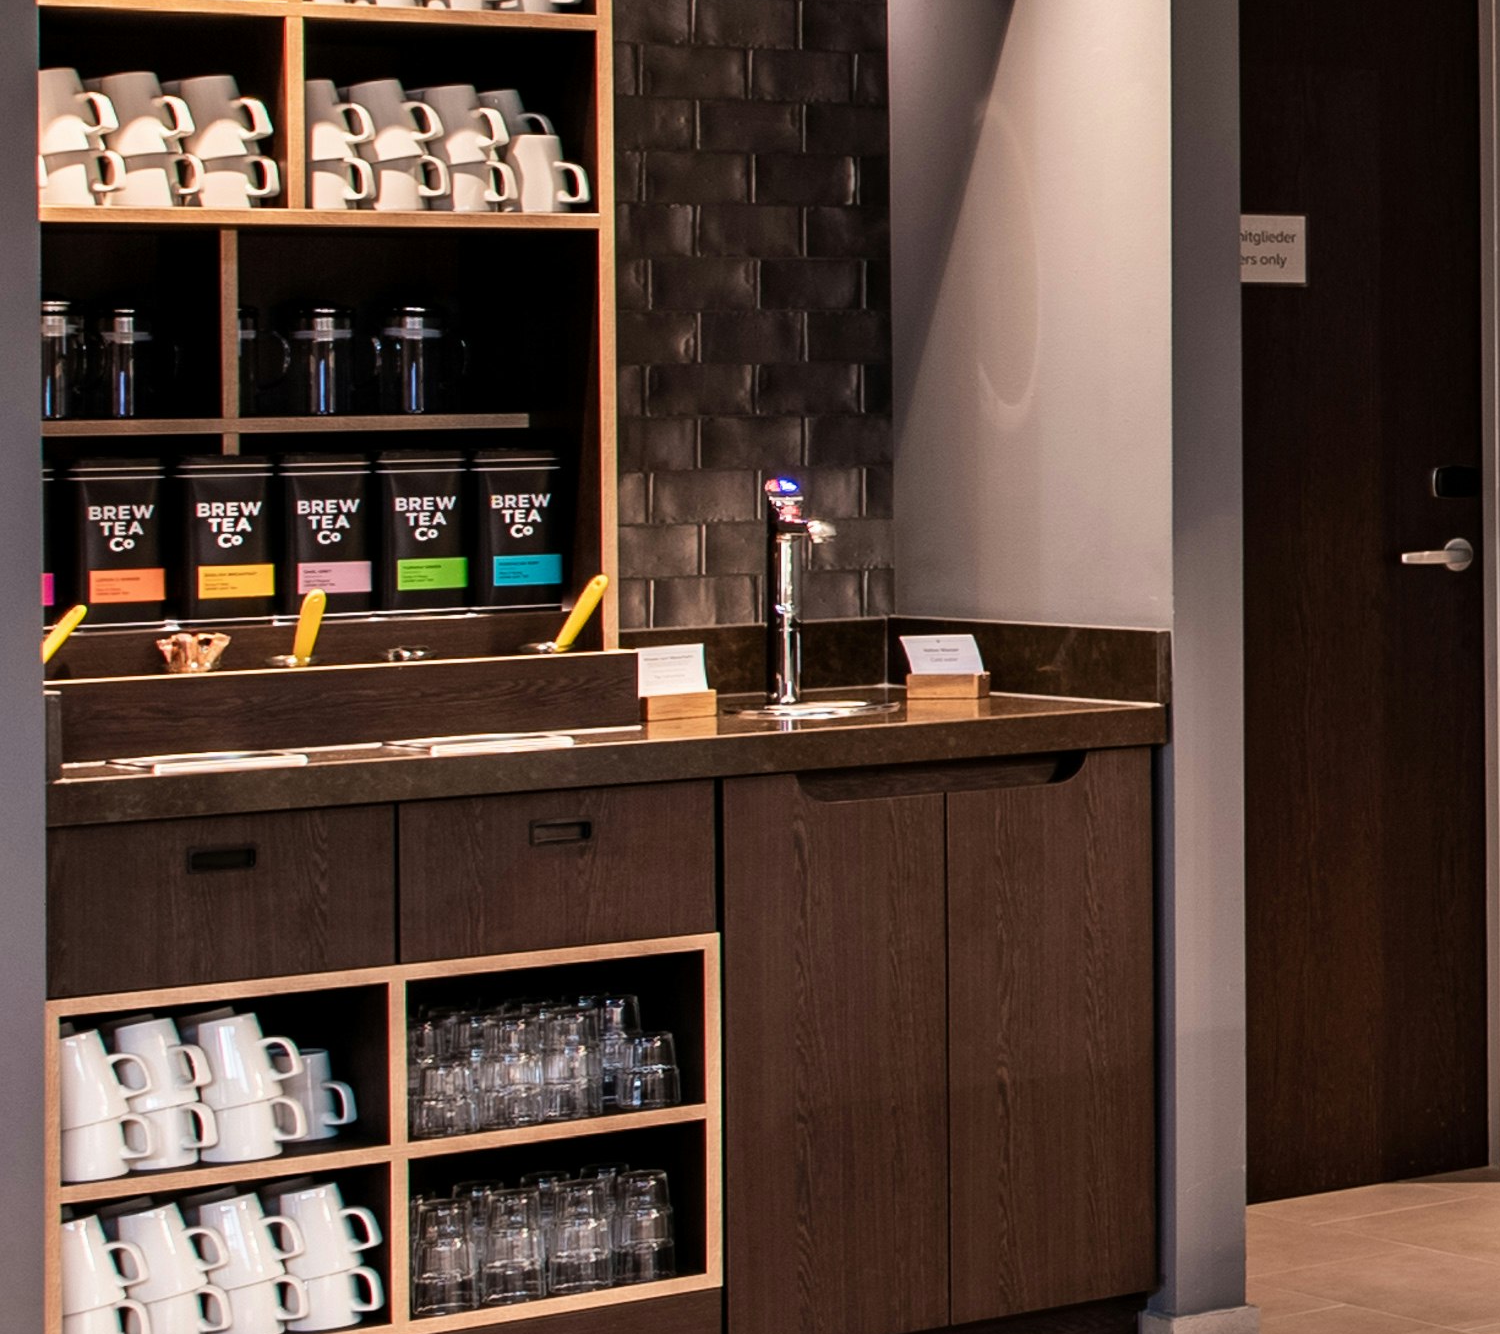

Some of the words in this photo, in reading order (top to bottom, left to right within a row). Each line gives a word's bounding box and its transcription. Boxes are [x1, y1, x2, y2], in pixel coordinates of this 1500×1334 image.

[1259, 253, 1288, 269] only
[196, 501, 262, 518] BREW
[296, 499, 360, 515] BREW
[394, 496, 456, 512] BREW
[490, 493, 551, 510] BREW
[87, 504, 154, 521] BREW
[405, 511, 447, 526] TEA
[501, 509, 542, 524] TEA
[99, 521, 144, 536] TEA
[207, 517, 252, 533] TEA
[307, 515, 351, 530] TEA
